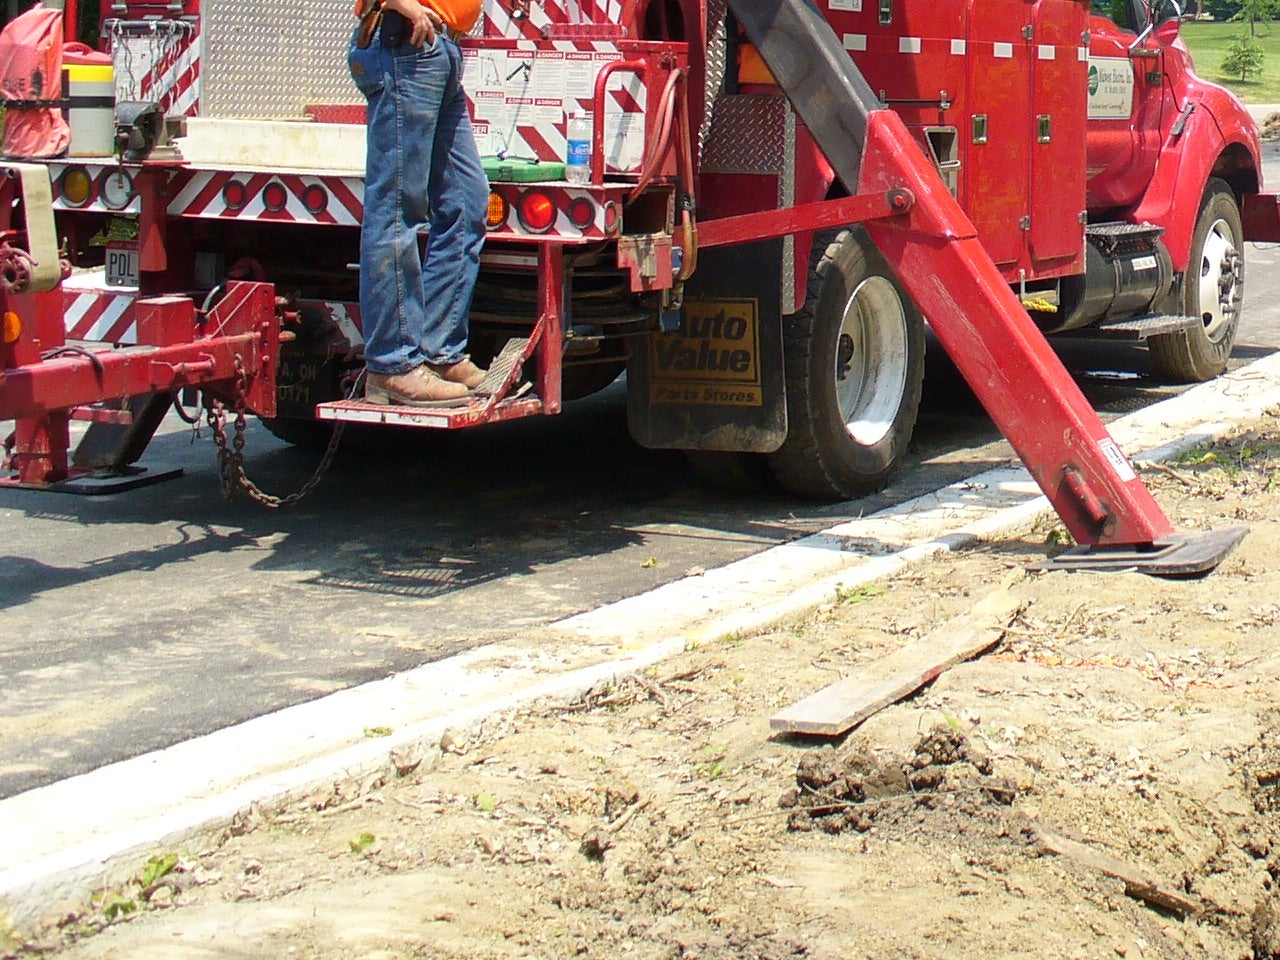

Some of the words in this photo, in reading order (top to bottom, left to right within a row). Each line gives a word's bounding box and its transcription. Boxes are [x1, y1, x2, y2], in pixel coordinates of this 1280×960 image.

[109, 253, 134, 277] PDL
[656, 340, 751, 373] Value
[656, 387, 698, 401] Parts
[703, 386, 755, 402] Stores
